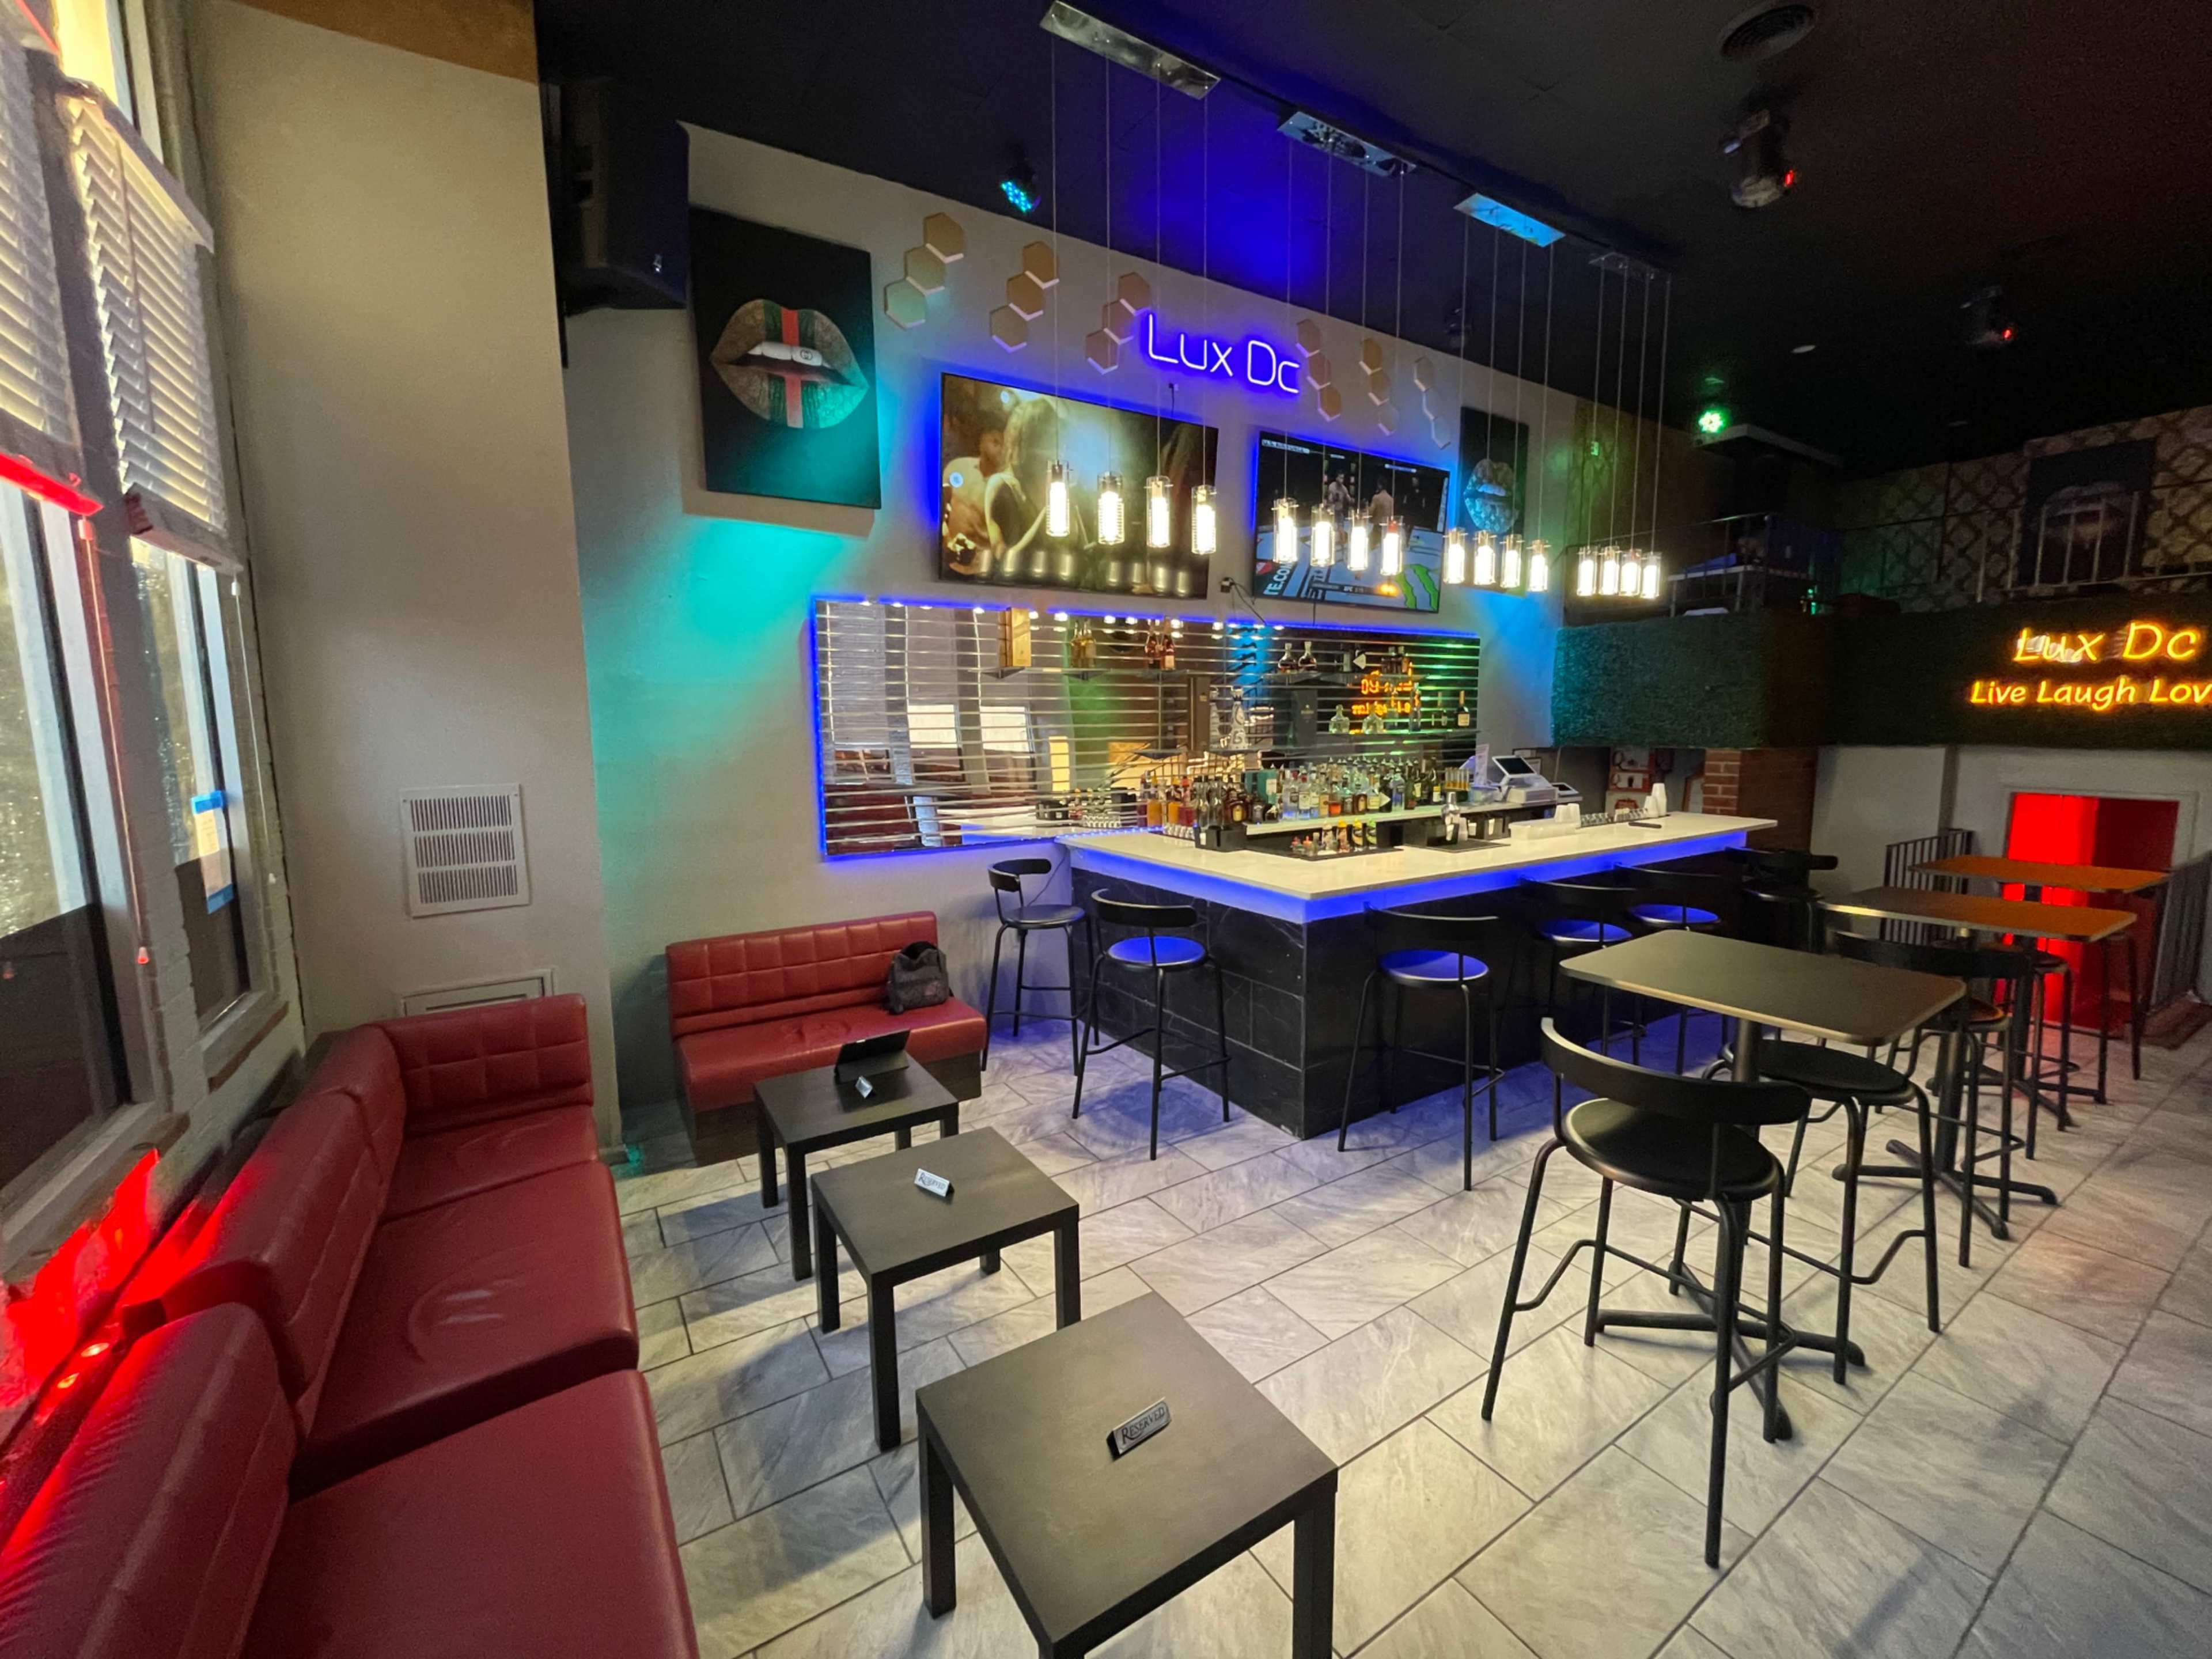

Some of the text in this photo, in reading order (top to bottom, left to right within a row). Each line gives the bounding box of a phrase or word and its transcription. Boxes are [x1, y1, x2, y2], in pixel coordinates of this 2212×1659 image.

[1148, 313, 1301, 394] Lux Dc
[2013, 620, 2198, 662] Lux Dc
[1969, 680, 2027, 704] Live
[2036, 676, 2137, 711] Laugh
[1121, 1406, 1165, 1445] RESERVED
